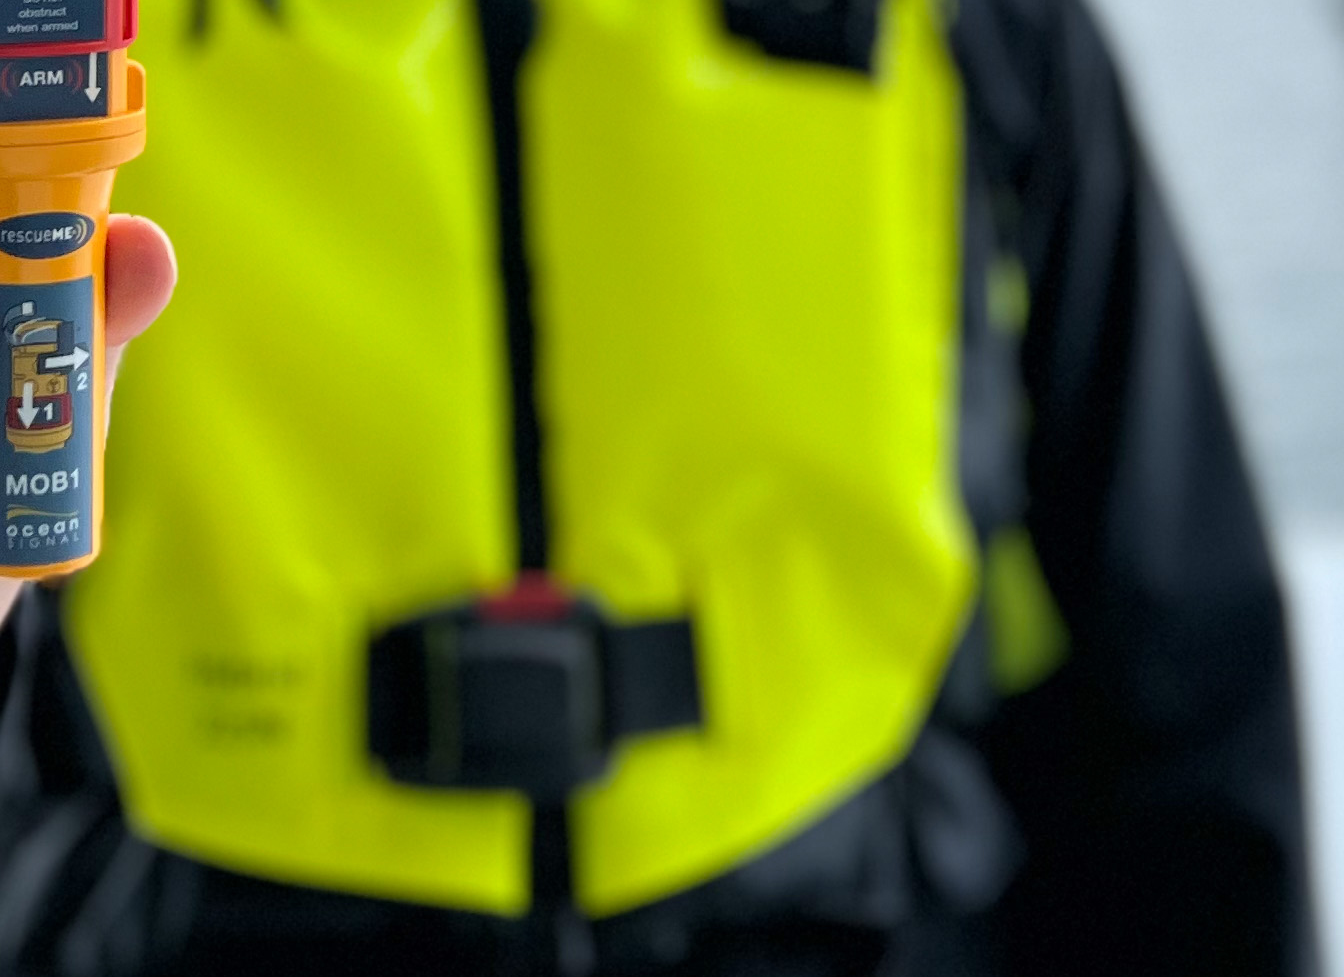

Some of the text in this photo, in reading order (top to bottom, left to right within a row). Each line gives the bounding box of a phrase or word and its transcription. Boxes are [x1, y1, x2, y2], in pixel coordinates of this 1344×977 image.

[18, 7, 67, 18] obstruct
[6, 20, 79, 33] when armed
[19, 69, 64, 87] ARM
[76, 372, 88, 391] 2
[43, 402, 54, 421] 1
[6, 468, 79, 496] MOB1
[6, 517, 79, 538] ocean
